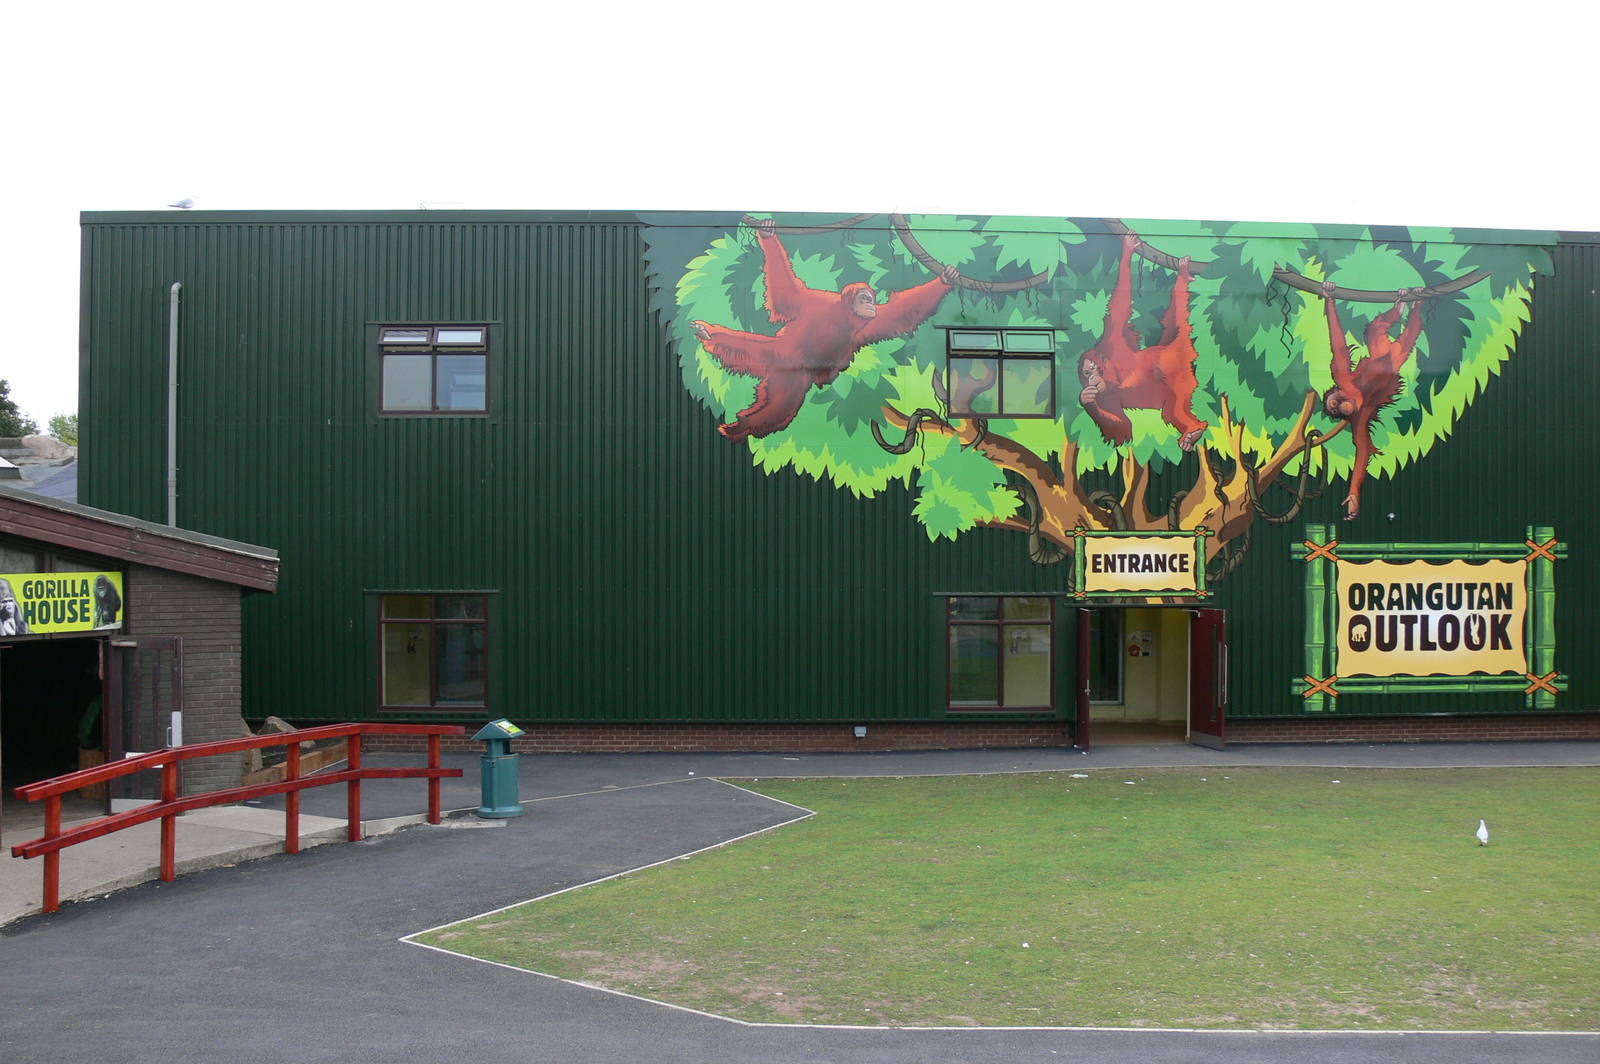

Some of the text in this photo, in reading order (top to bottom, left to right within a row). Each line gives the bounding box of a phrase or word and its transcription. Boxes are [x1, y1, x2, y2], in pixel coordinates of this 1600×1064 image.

[1092, 553, 1189, 573] ENTRANCE
[23, 579, 90, 599] GORILLA
[1348, 582, 1513, 611] ORANGUTAN
[23, 599, 90, 625] HOUSE
[1348, 613, 1513, 652] OUTLOOK
